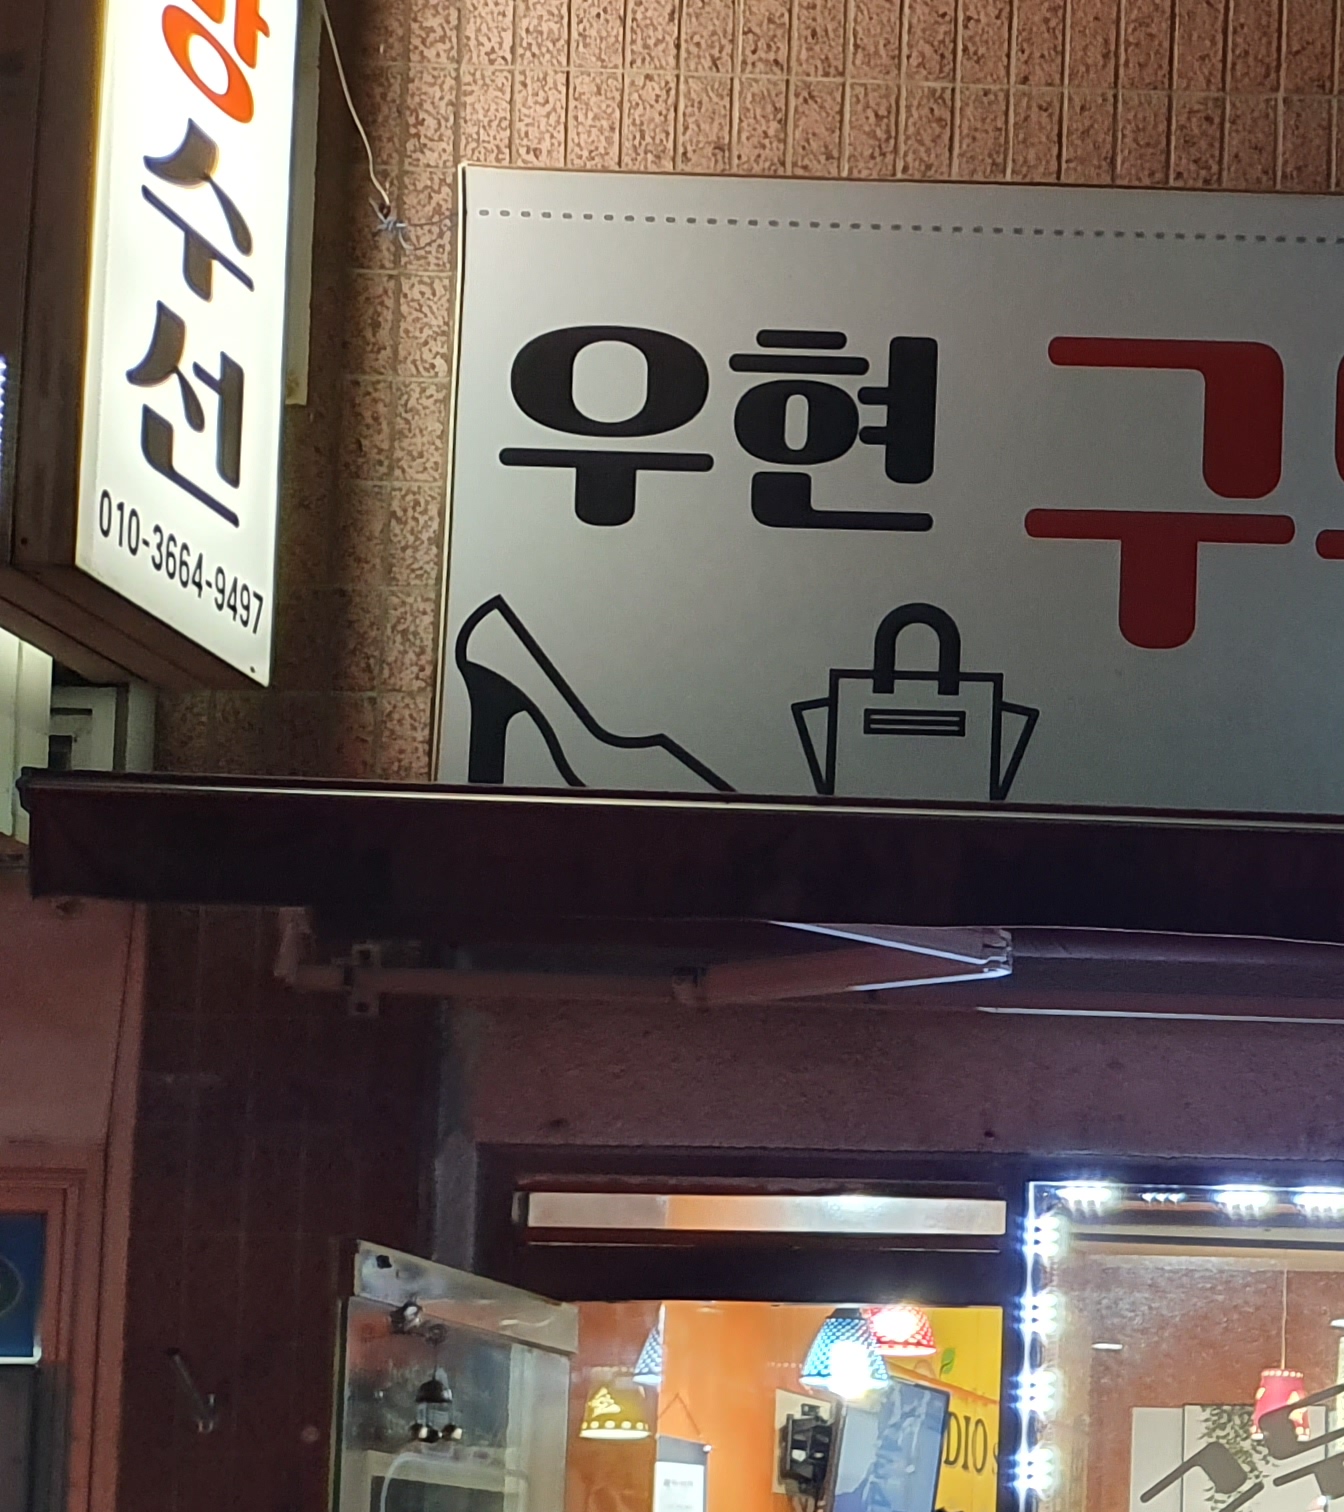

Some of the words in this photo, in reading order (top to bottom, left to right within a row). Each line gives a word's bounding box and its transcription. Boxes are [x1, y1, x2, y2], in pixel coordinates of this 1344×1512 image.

[126, 118, 254, 528] 수선
[498, 324, 938, 533] 우현
[98, 488, 265, 636] 010-3664-9497
